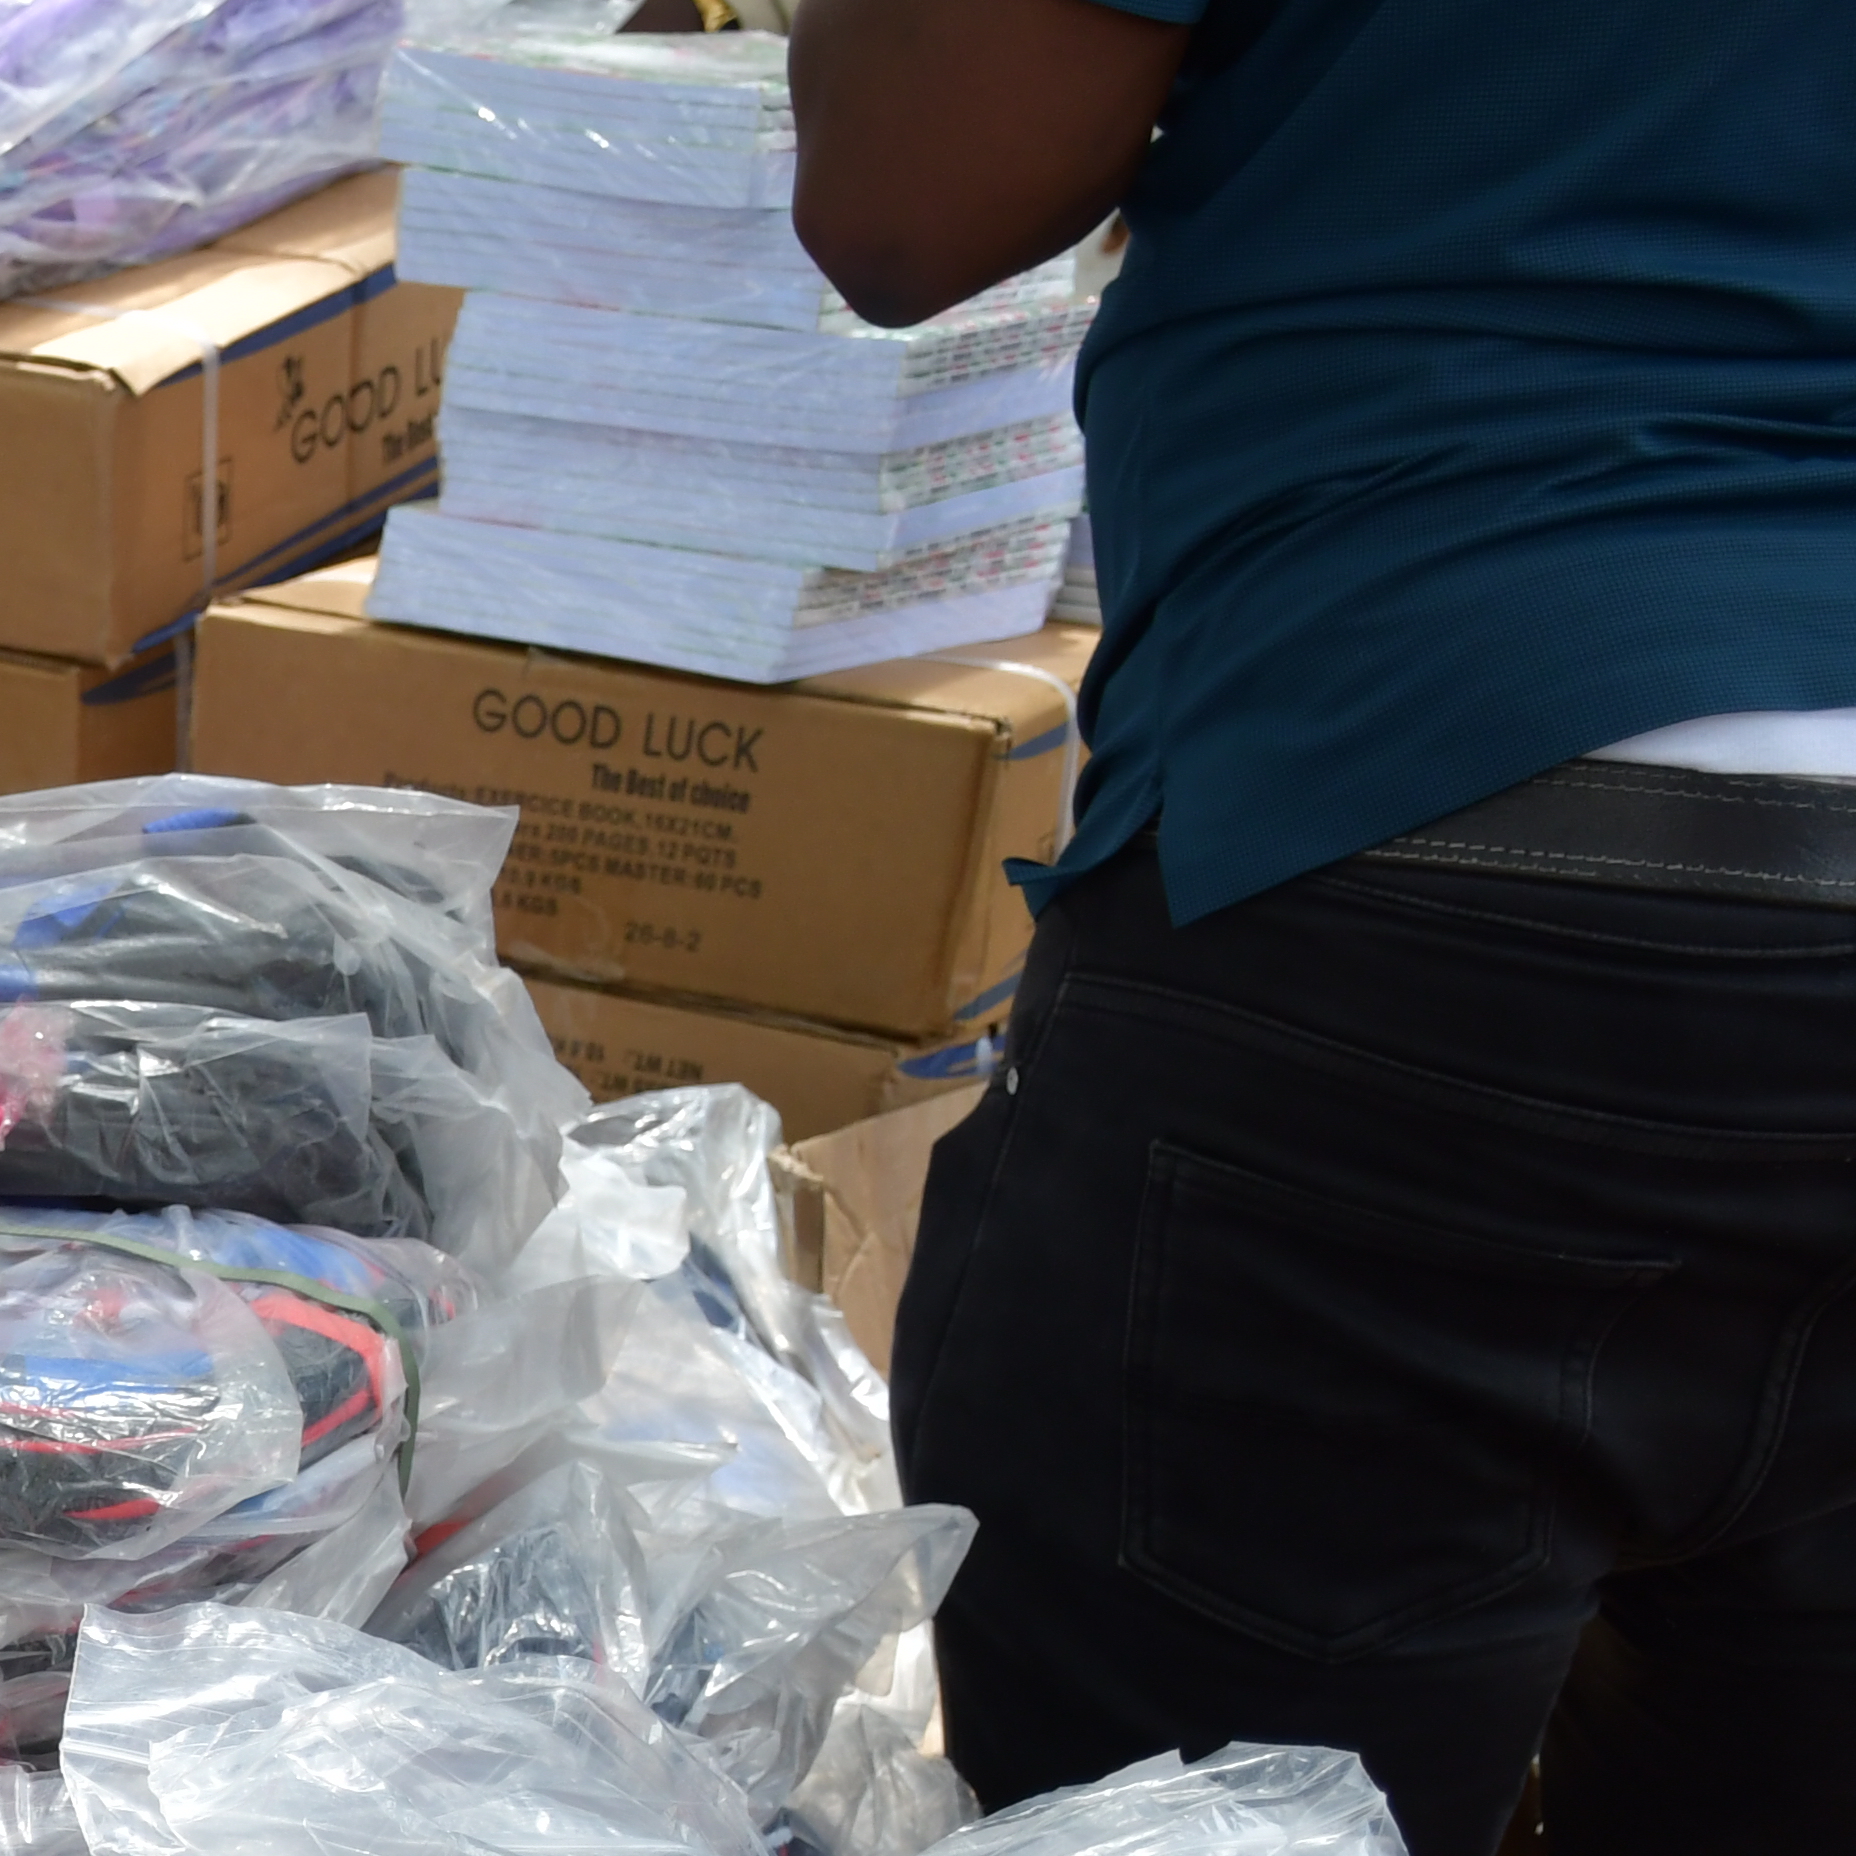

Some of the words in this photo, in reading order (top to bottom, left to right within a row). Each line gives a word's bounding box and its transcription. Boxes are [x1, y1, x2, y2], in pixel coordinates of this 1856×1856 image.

[290, 365, 401, 465] GOOD
[472, 688, 622, 750] GOOD
[642, 711, 764, 773] LUCK
[591, 762, 623, 793] The
[626, 768, 666, 801] Best
[690, 781, 751, 815] choice
